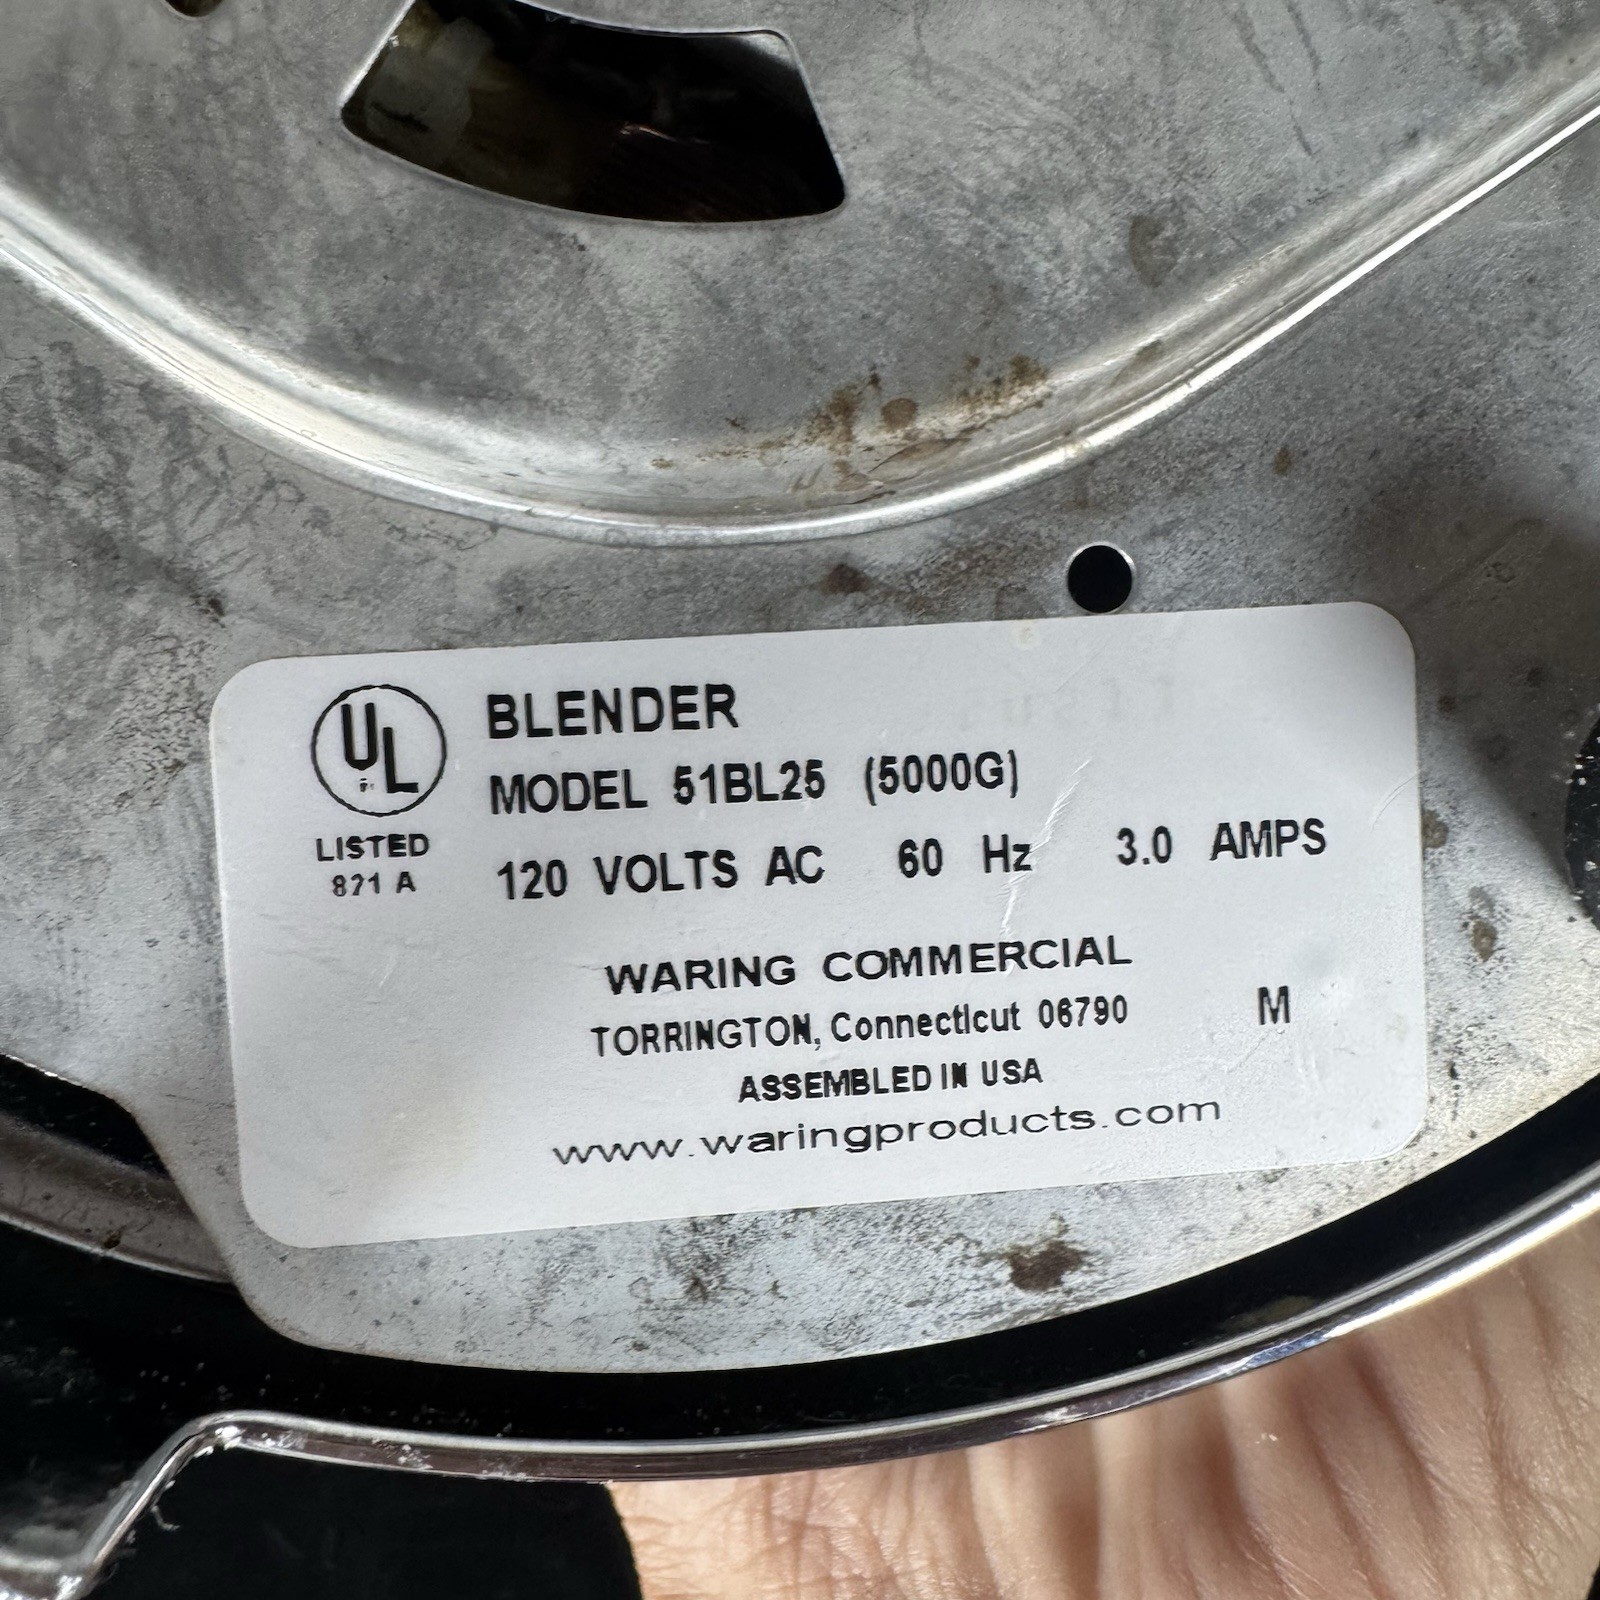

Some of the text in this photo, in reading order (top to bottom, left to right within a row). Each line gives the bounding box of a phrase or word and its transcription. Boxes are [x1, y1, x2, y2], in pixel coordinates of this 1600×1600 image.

[486, 683, 740, 740] BLENDER
[339, 701, 420, 795] UL
[489, 749, 1019, 816] MODEL 51BL25 (5000G)
[315, 832, 431, 863] LISTED
[496, 817, 1328, 901] 120 VOLTS AC 60 Hz 3.0 AMPS
[395, 870, 417, 894] A
[603, 934, 1134, 996] WARING COMMERCIAL
[589, 1012, 822, 1058] TORRINGTON,
[1037, 994, 1129, 1030] 06790
[1257, 984, 1291, 1026] M
[737, 1057, 1044, 1104] ASSEMBLED IN USA
[551, 1101, 1221, 1166] www.waringproducts.com
